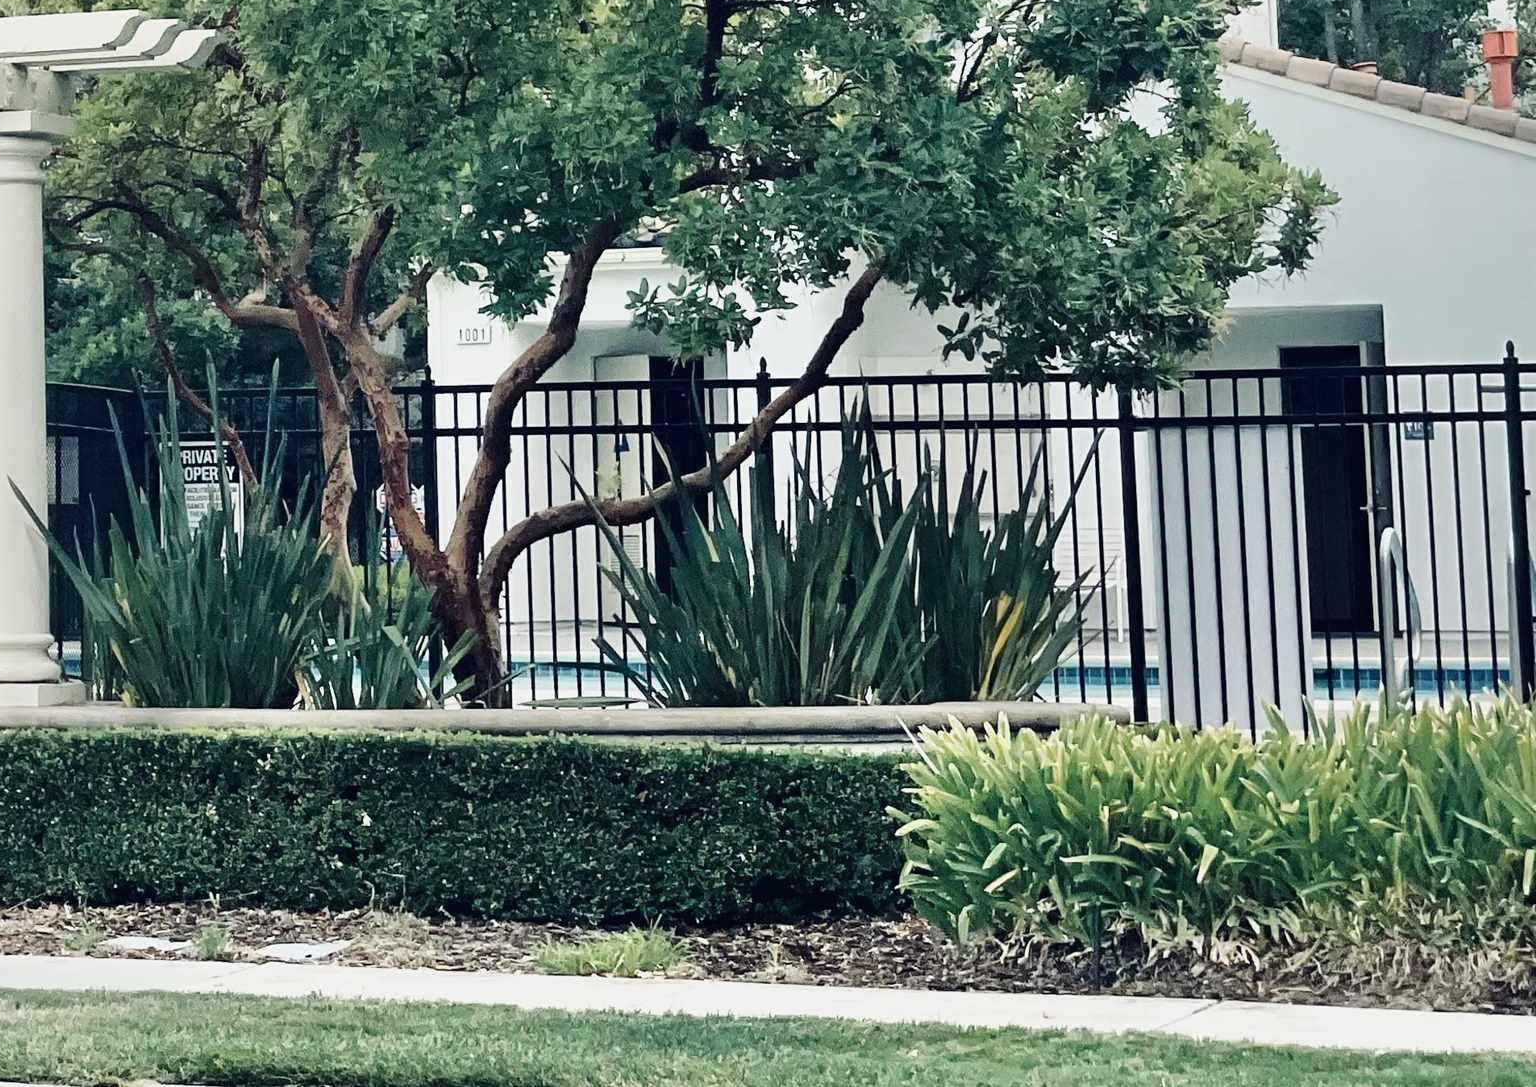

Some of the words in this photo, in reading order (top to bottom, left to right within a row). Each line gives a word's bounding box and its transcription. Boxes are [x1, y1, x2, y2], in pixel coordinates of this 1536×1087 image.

[459, 327, 485, 342] 1001
[181, 448, 228, 465] RIVAT
[184, 465, 236, 481] OPERY
